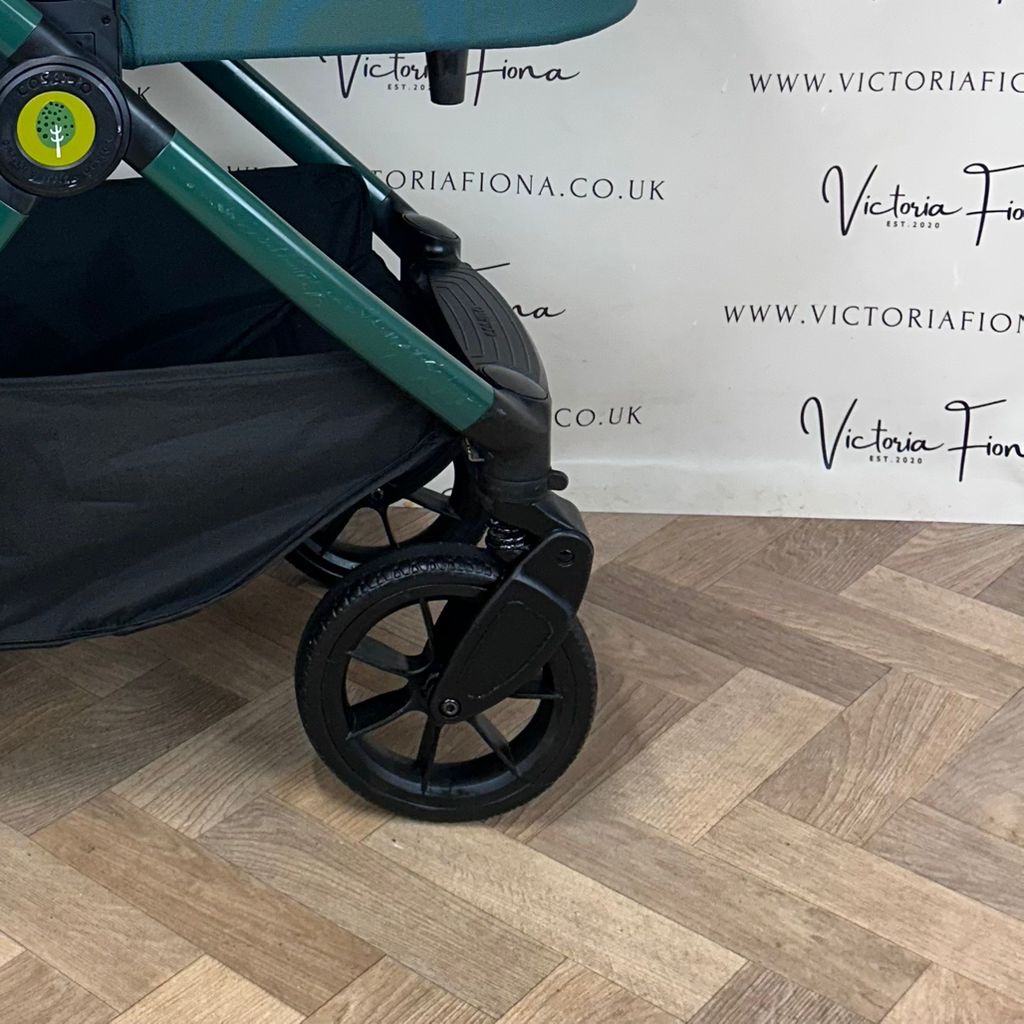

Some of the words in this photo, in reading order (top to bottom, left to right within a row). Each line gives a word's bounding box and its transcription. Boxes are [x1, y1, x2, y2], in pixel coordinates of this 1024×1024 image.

[822, 164, 963, 236] Victoria
[886, 221, 941, 230] EST.2020
[800, 396, 944, 470] Victoria
[868, 455, 923, 464] EST.2020
